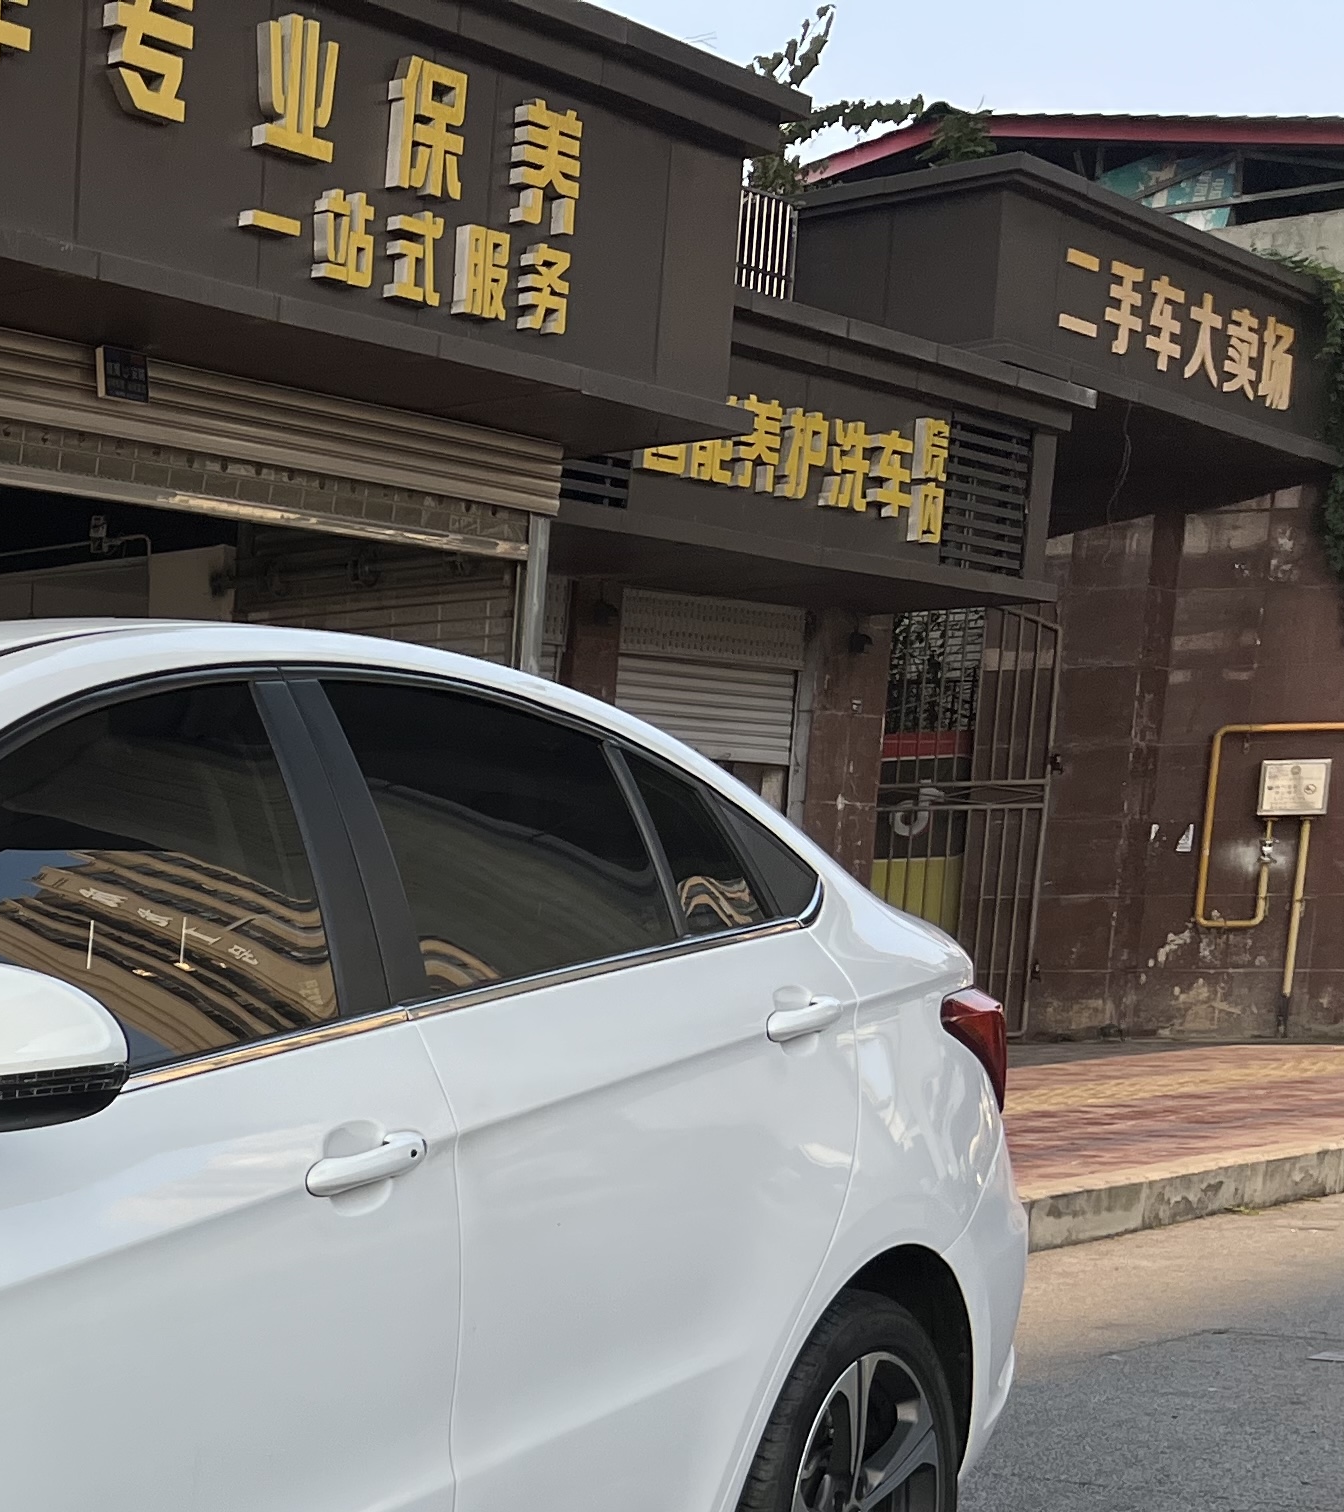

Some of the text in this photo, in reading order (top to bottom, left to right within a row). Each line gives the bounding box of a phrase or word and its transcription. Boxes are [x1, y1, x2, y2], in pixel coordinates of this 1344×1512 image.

[238, 188, 573, 336] 一站式服务
[1059, 247, 1294, 411] 二手车大卖场
